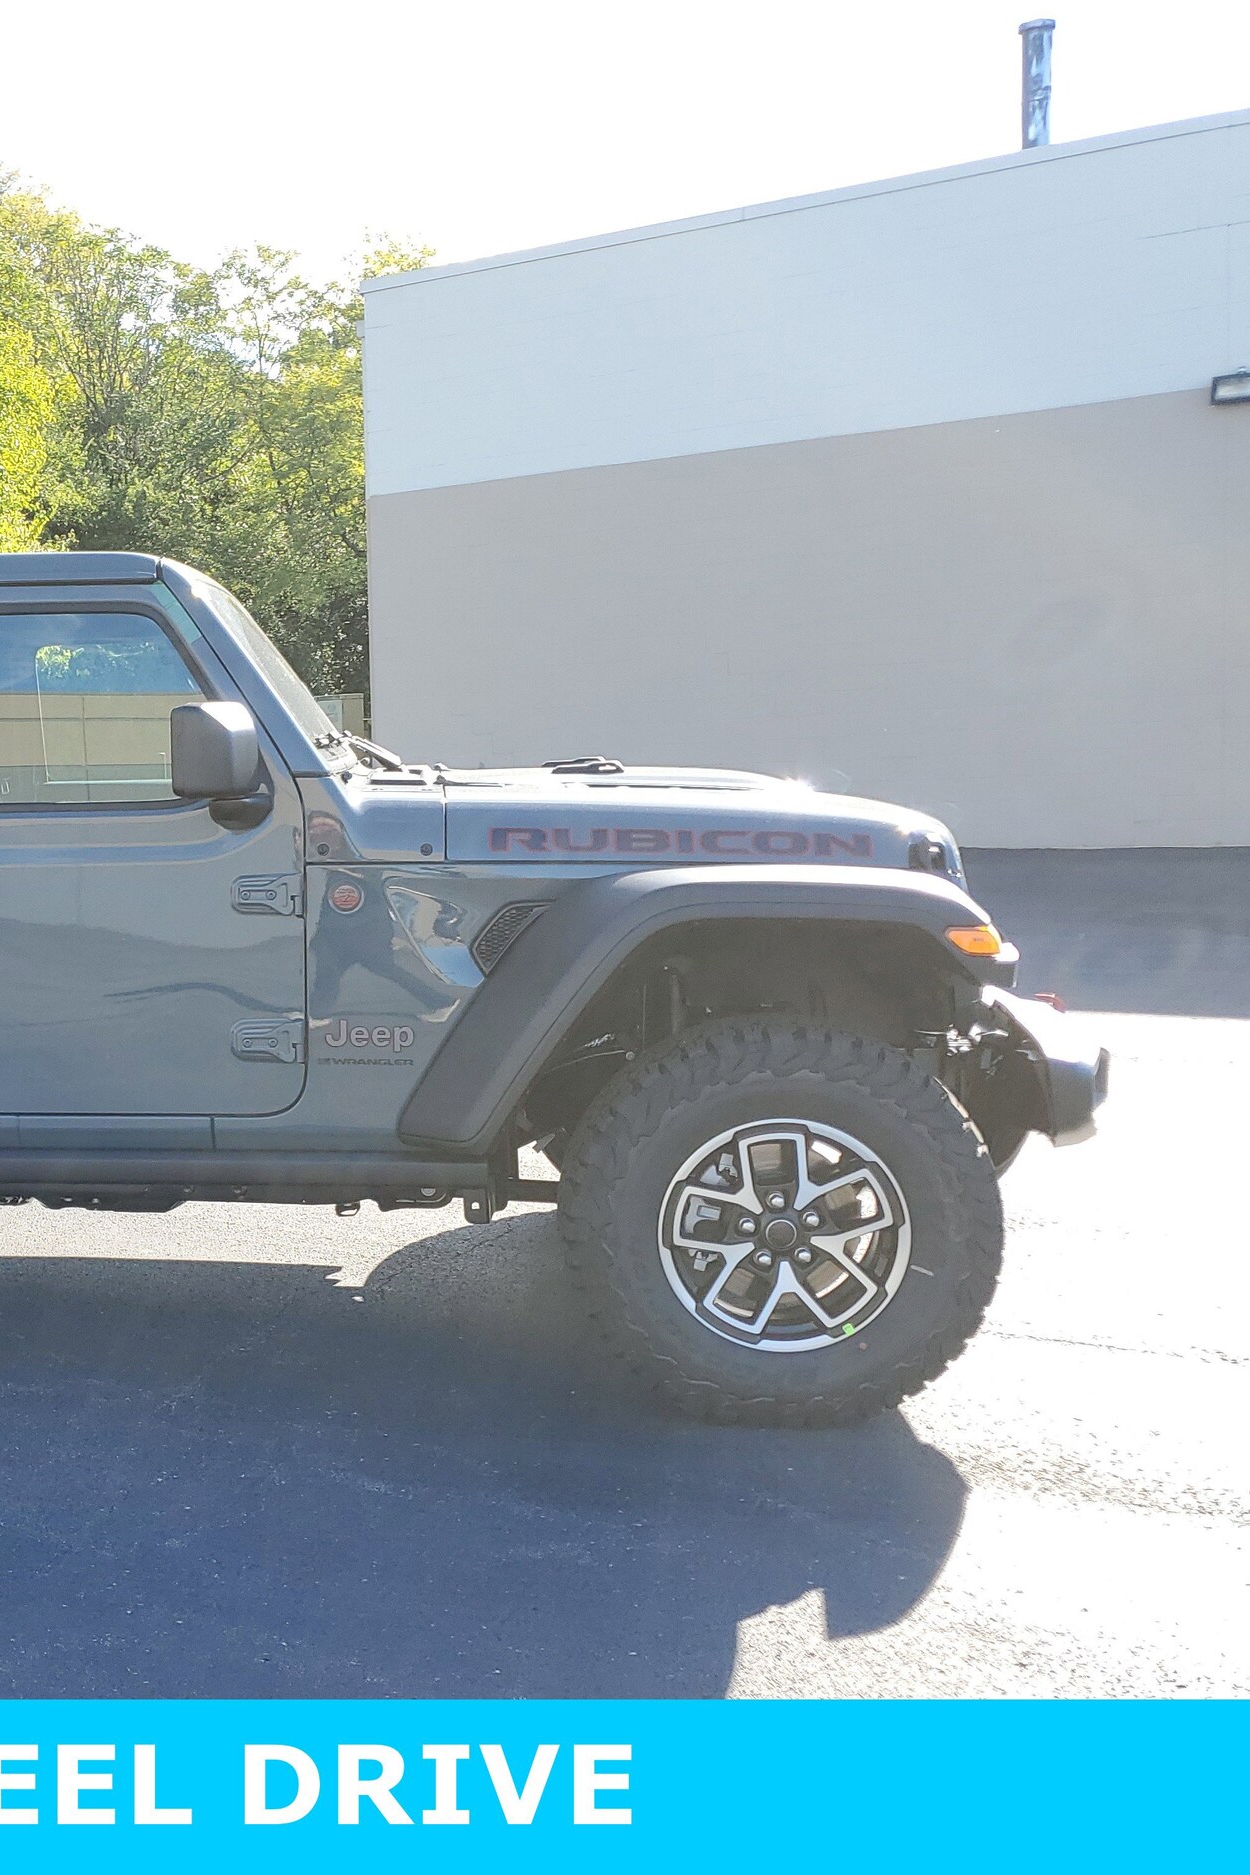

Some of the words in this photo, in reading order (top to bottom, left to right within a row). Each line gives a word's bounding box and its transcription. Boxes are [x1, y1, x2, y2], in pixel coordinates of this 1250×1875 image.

[489, 826, 873, 858] RUBICON
[325, 1019, 415, 1053] Jeep
[332, 1057, 414, 1067] WRANGLER
